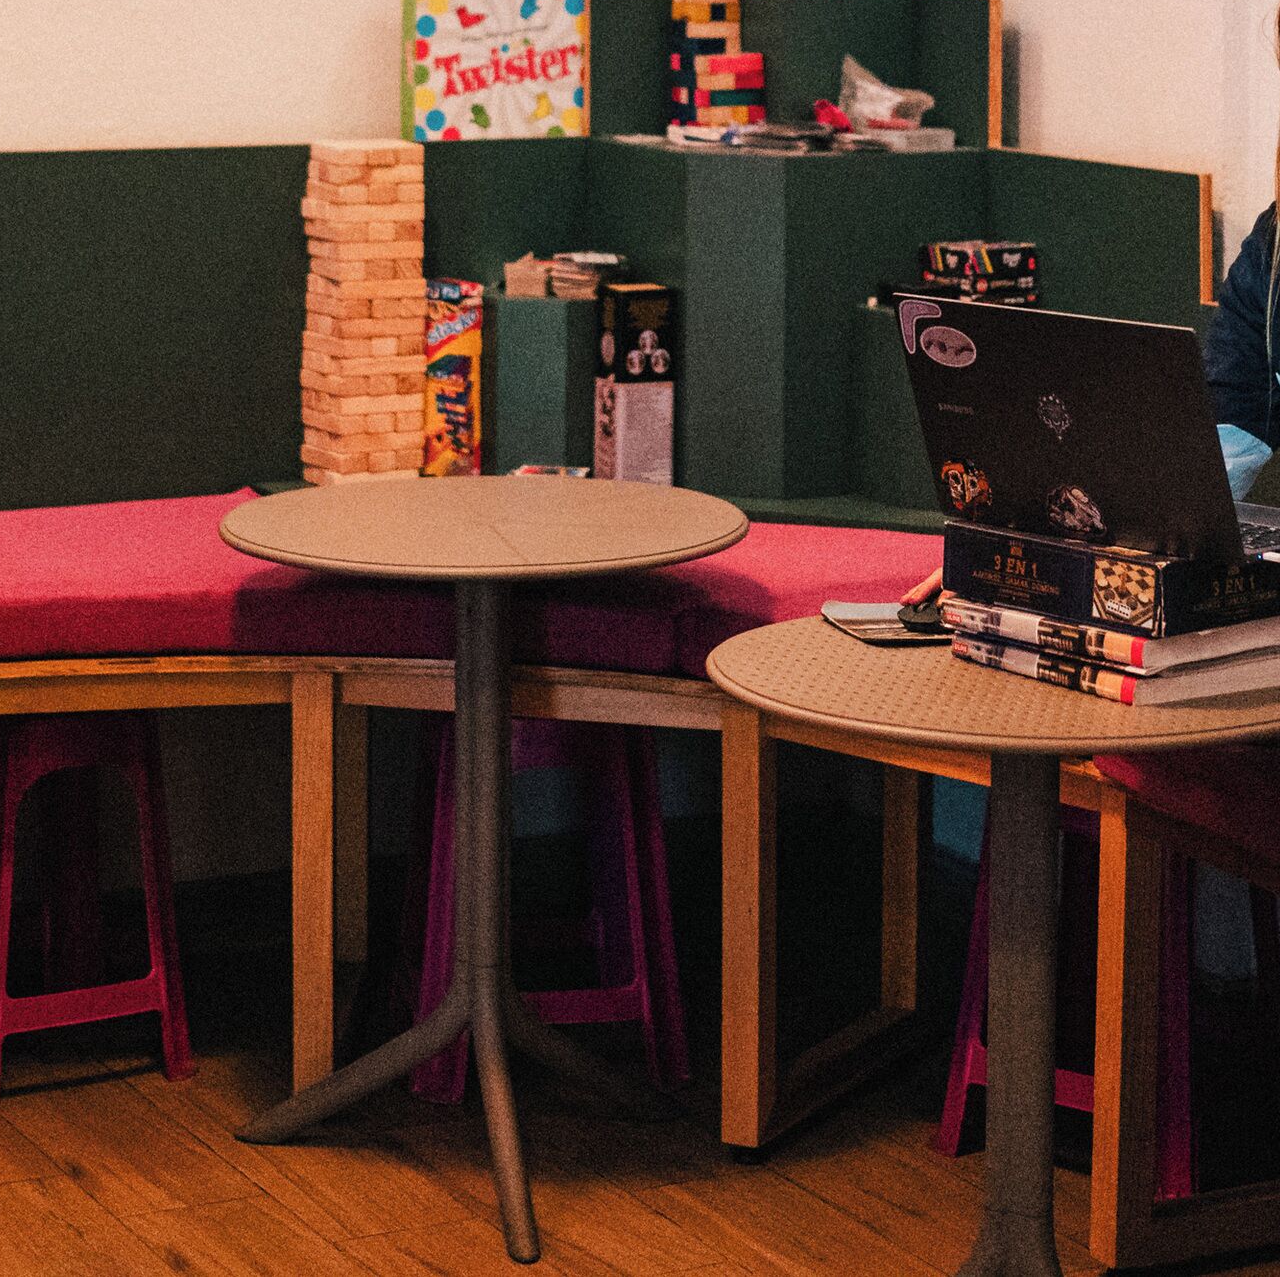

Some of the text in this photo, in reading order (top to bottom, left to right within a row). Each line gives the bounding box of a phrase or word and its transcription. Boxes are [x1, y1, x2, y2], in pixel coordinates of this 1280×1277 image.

[434, 43, 579, 98] Twister
[994, 555, 1037, 578] 3 EN 1
[1225, 578, 1244, 594] EN
